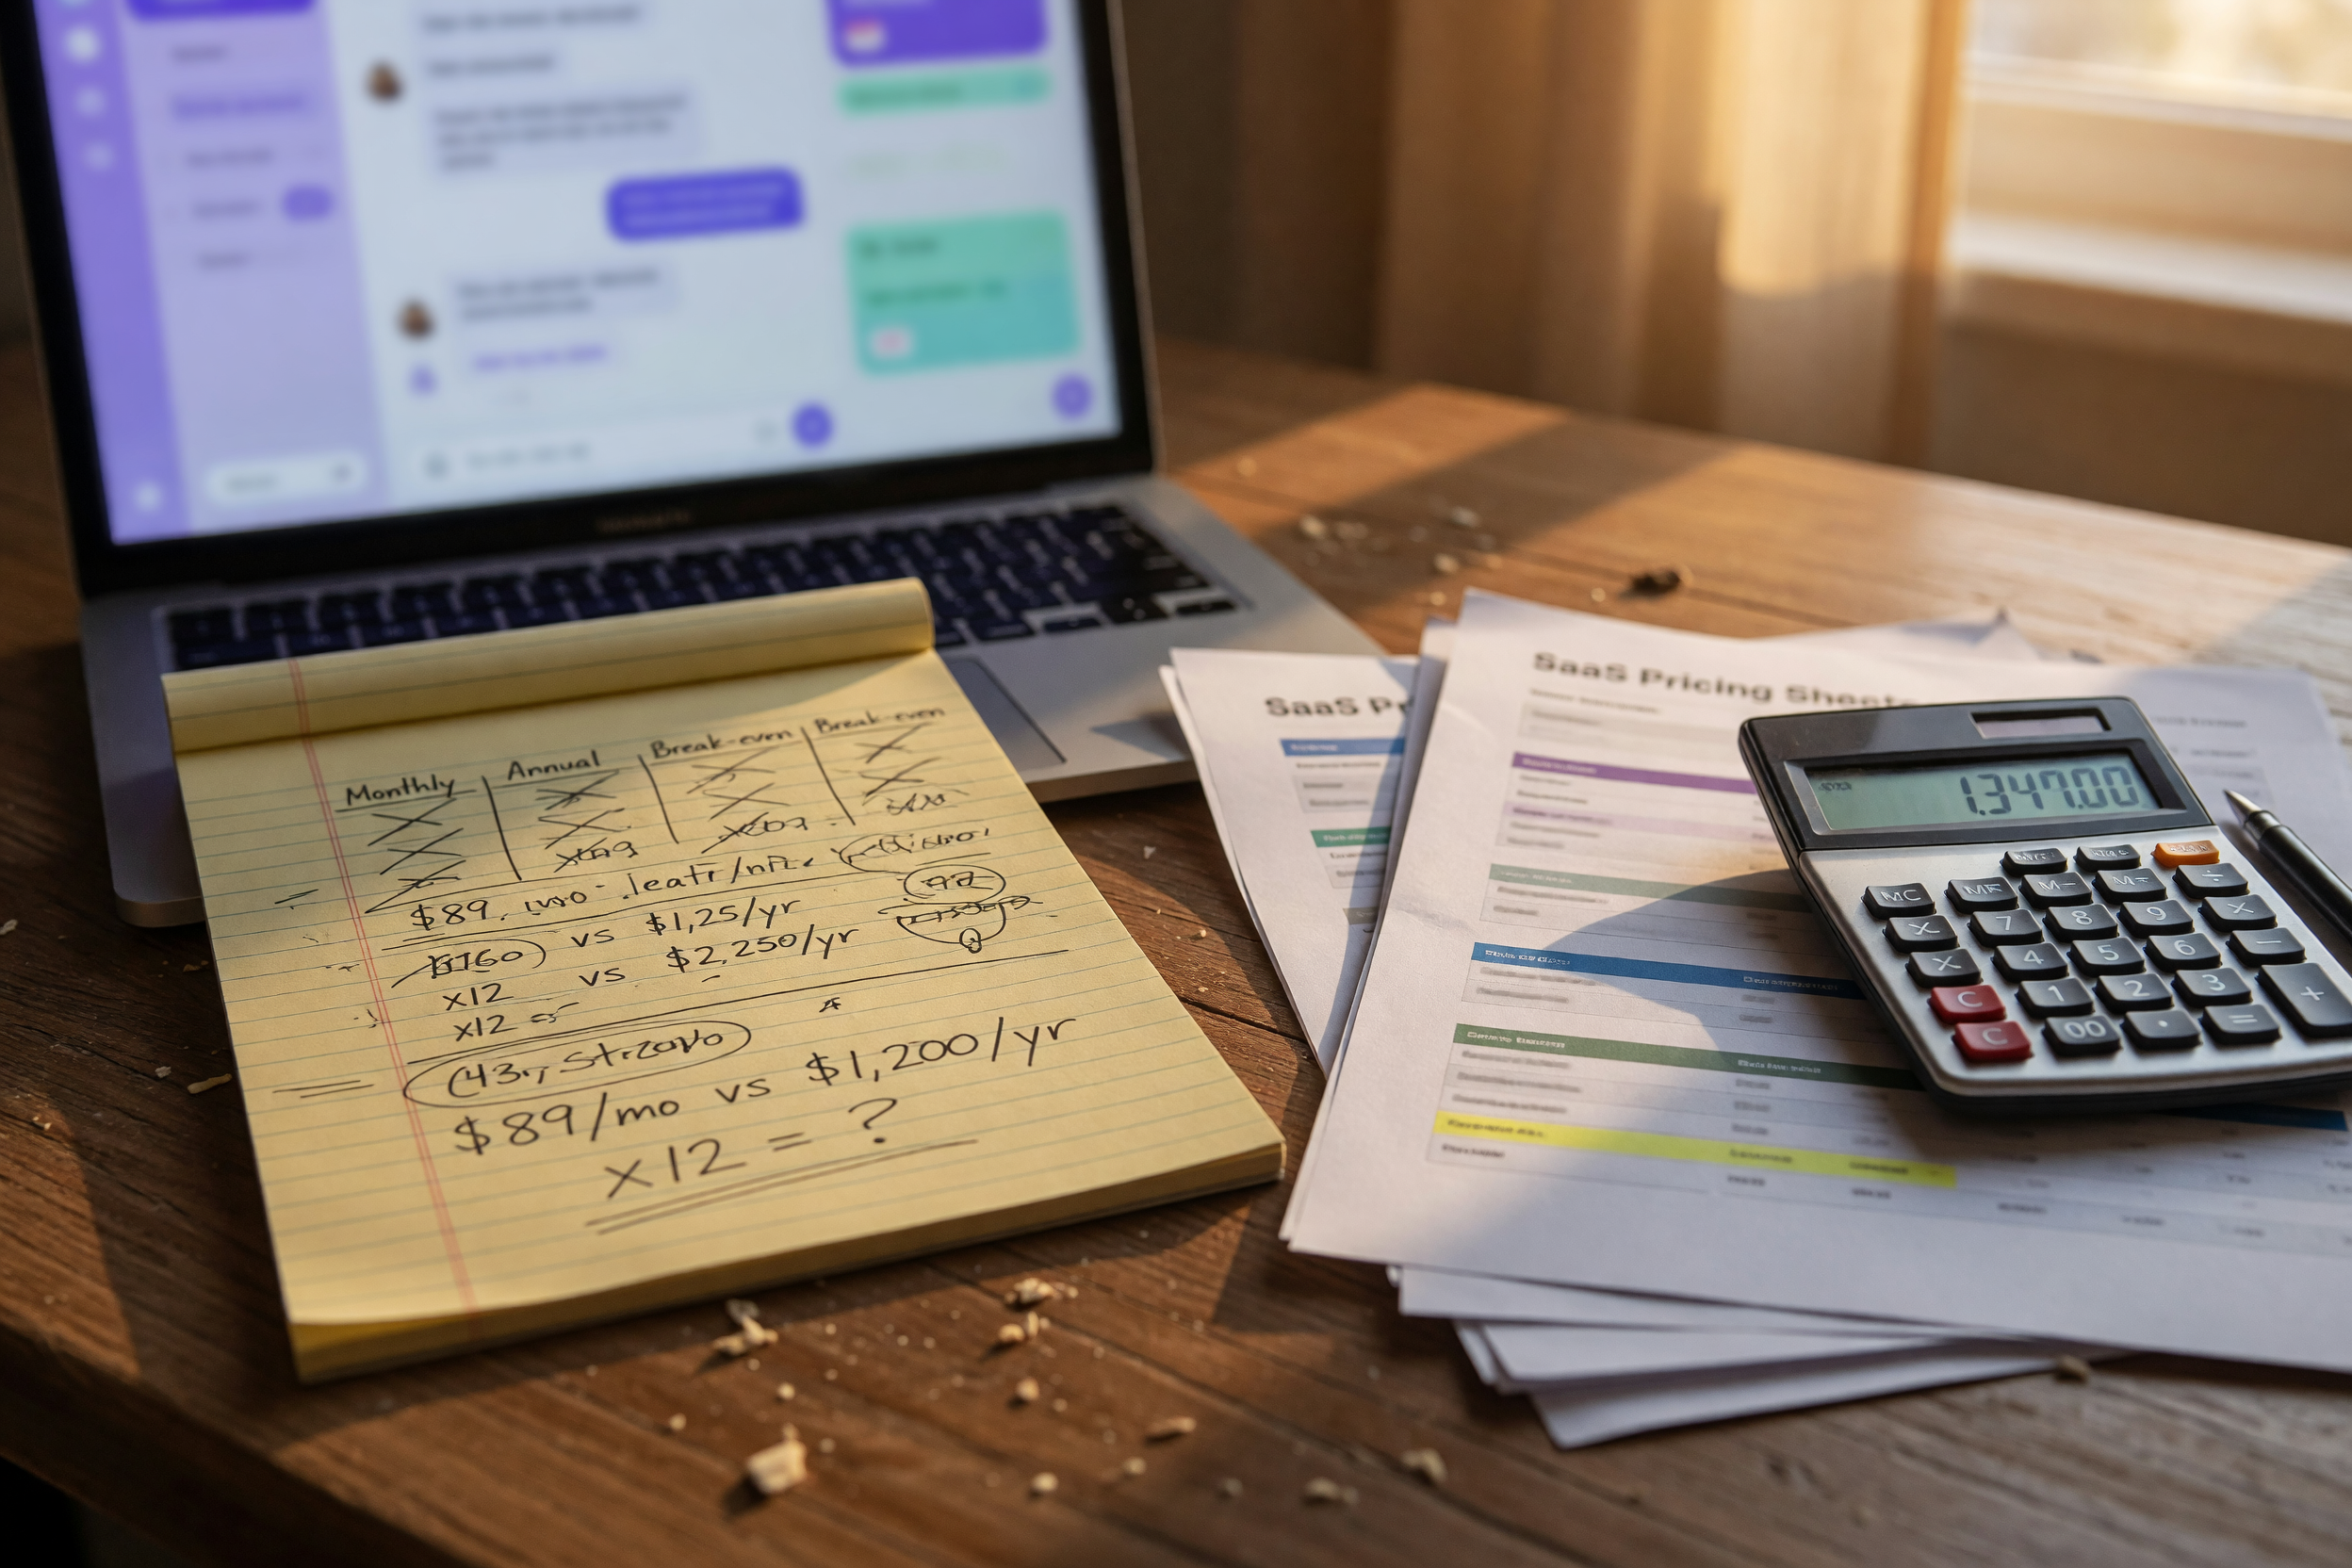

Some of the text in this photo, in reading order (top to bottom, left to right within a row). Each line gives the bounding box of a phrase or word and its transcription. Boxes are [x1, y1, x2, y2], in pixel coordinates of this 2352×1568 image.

[1535, 652, 1628, 684] SaaS
[1640, 668, 1773, 704] Pricing
[1265, 695, 1360, 717] SaaS
[814, 704, 946, 734] Break-even
[650, 727, 794, 760] Break-even
[507, 750, 601, 781] Annual
[346, 774, 455, 807] Monthly
[570, 896, 801, 949] vs $1,25/yr
[2071, 910, 2094, 925] 8
[2146, 906, 2167, 921] 9
[1995, 915, 2013, 931] 7
[2098, 943, 2120, 961] 5
[2174, 939, 2197, 956] 6
[2022, 949, 2046, 966] 4
[578, 967, 627, 988] vs
[2201, 973, 2227, 991] 3
[2048, 985, 2065, 1003] 1
[2124, 980, 2151, 998] 2
[1956, 990, 1984, 1008] C
[1982, 1027, 2009, 1046] C
[2064, 1020, 2108, 1038] 00
[453, 1017, 1077, 1156] $89/mo vs $1,200/yr
[767, 1132, 814, 1152] =
[847, 1096, 898, 1146] ?
